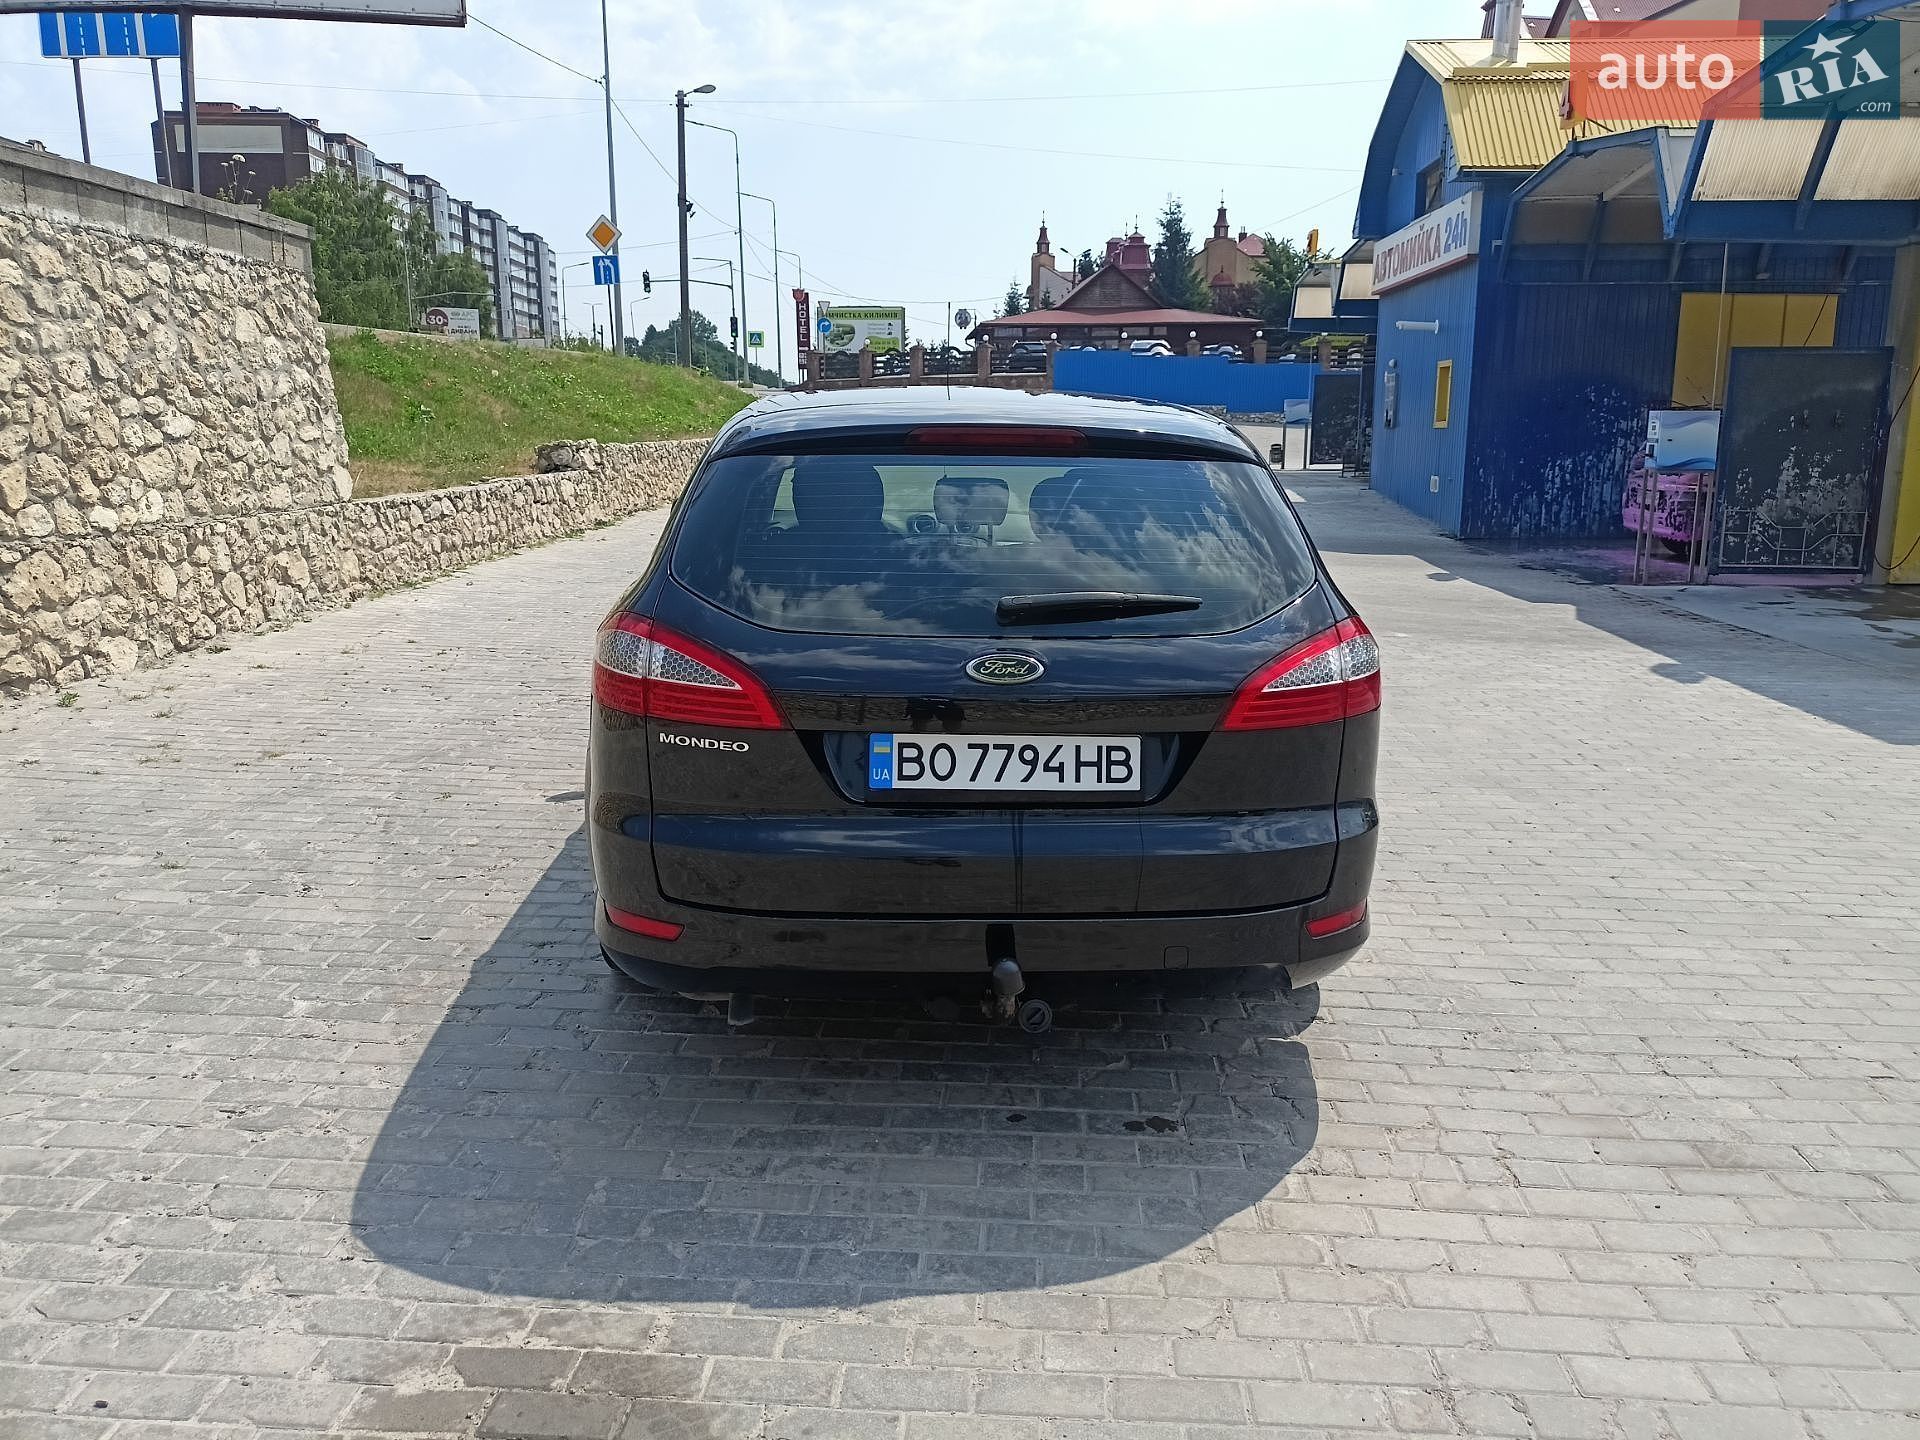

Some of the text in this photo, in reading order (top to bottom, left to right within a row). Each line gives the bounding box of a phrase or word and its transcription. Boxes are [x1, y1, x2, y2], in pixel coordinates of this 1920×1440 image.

[1373, 210, 1468, 285] АВТОМИЙКА 24h
[799, 303, 808, 341] HOTEL
[981, 660, 1030, 675] Ford
[659, 732, 750, 752] MONDEO
[873, 768, 890, 780] UA
[967, 743, 1065, 783] 7794
